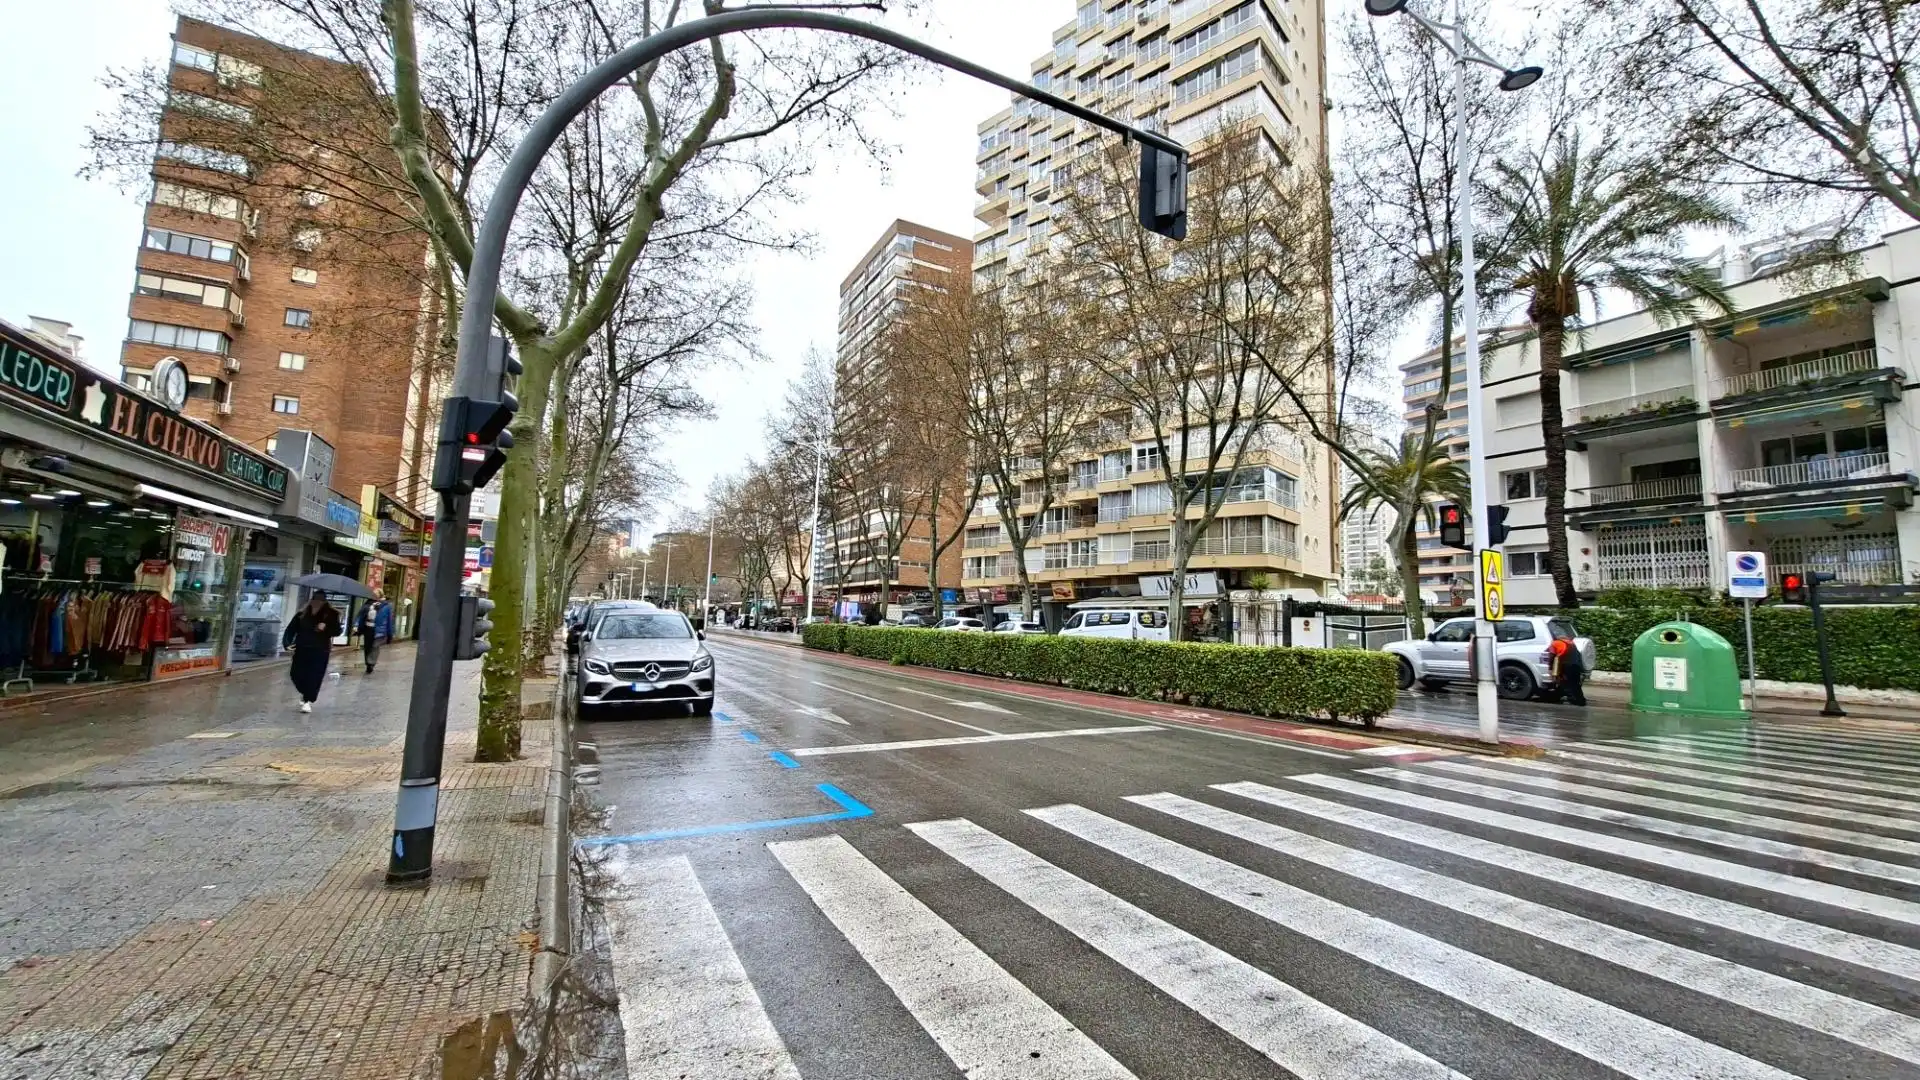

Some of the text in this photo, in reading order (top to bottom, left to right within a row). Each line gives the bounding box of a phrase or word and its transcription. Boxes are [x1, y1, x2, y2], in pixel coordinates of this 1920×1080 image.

[0, 343, 70, 406] LEDER
[110, 392, 220, 469] EL CIERVO
[226, 449, 264, 485] LEATHER
[1489, 597, 1499, 609] 30
